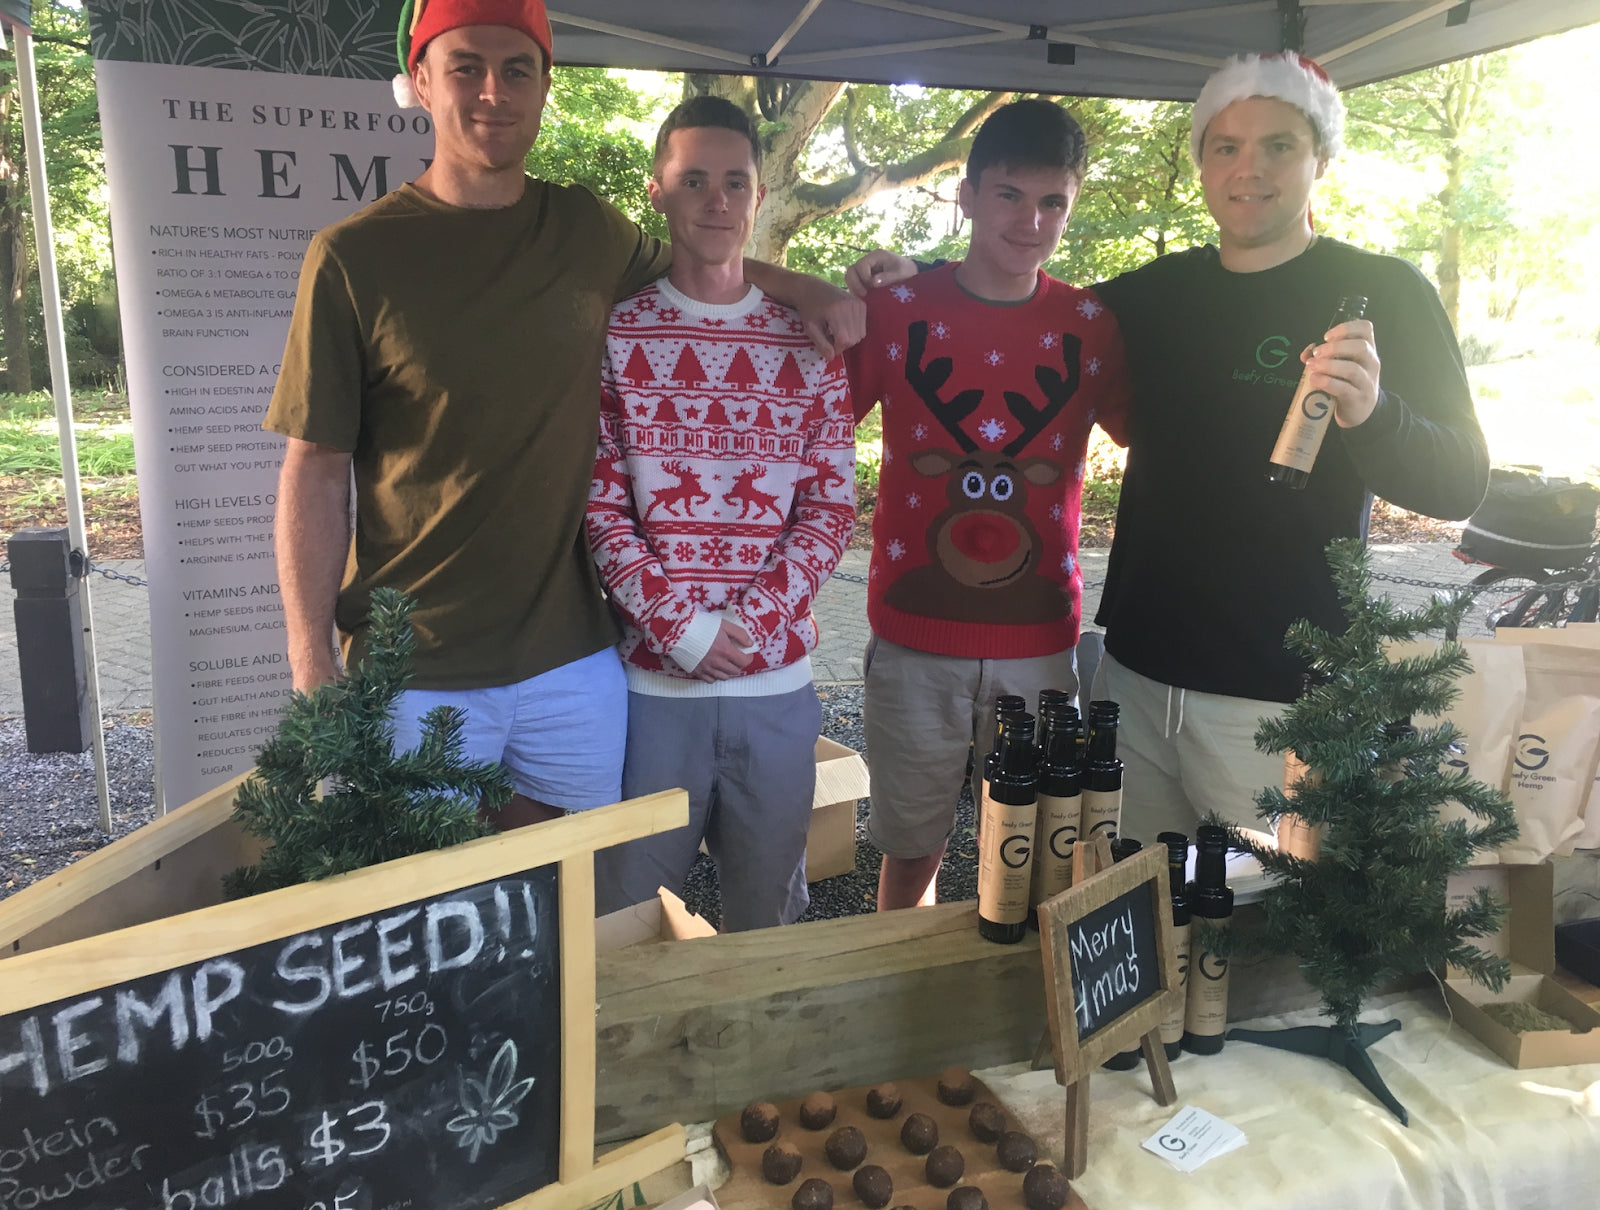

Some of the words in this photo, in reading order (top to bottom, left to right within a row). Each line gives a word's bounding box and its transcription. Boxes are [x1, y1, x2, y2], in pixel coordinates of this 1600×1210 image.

[163, 98, 234, 123] THE
[253, 104, 430, 135] SUPERFOO
[150, 225, 219, 238] NATURE'S
[224, 227, 264, 240] MOST
[268, 229, 318, 241] NUTRIE
[158, 249, 182, 258] RICH
[186, 249, 196, 258] IN
[200, 250, 244, 259] HEALTHY
[246, 251, 270, 260] FATS
[156, 268, 188, 278] RATIO
[190, 269, 206, 278] OF
[208, 270, 222, 279] 3:1
[224, 270, 264, 279] OMEGA
[266, 270, 272, 279] 6
[274, 270, 288, 280] TO
[290, 271, 302, 280] O
[162, 288, 201, 298] OMEGA
[204, 290, 211, 298] 6
[213, 289, 274, 298] METABOLITE
[163, 309, 204, 318] OMEGA
[206, 309, 212, 318] 3
[214, 309, 224, 318] IS
[162, 328, 193, 338] BRAIN
[196, 328, 249, 338] FUNCTION
[162, 365, 255, 377] CONSIDERED
[258, 364, 270, 376] A
[171, 388, 197, 396] HIGH
[200, 388, 210, 396] IN
[213, 386, 254, 396] EDESTIN
[169, 406, 206, 416] AMINO
[208, 406, 238, 414] ACIDS
[240, 404, 262, 414] AND
[174, 426, 203, 434] HEMP
[206, 425, 231, 434] SEED
[176, 445, 206, 454] HEMP
[208, 444, 232, 452] SEED
[236, 442, 276, 452] PROTEIN
[174, 464, 196, 472] OUT
[198, 462, 228, 472] WHAT
[230, 461, 252, 470] YOU
[254, 460, 272, 469] PUT
[175, 498, 210, 510] HIGH
[215, 495, 262, 508] LEVELS
[265, 494, 277, 506] O
[183, 519, 211, 528] HEMP
[214, 517, 244, 527] SEEDS
[246, 514, 275, 524] PROD
[184, 537, 214, 546] HELPS
[216, 536, 242, 545] WITH
[268, 533, 274, 541] P
[186, 554, 234, 565] ARGININE
[236, 553, 244, 562] IS
[246, 551, 275, 560] ANTI-I
[182, 586, 247, 601] VITAMINS
[250, 584, 280, 596] AND
[194, 608, 222, 618] HEMP
[224, 606, 254, 616] SEEDS
[256, 603, 284, 614] INCLU
[189, 656, 249, 672] SOLUBLE
[252, 652, 282, 666] AND
[197, 678, 222, 689] FIBRE
[226, 676, 254, 686] FEEDS
[257, 673, 278, 682] OUR
[198, 696, 219, 706] GUT
[220, 693, 256, 704] HEALTH
[259, 690, 280, 699] AND
[200, 715, 218, 724] THE
[221, 712, 246, 722] FIBRE
[248, 710, 258, 718] IN
[261, 708, 281, 717] HEM
[198, 728, 252, 742] REGULATES
[202, 746, 246, 758] REDUCES
[201, 764, 233, 776] SUGAR
[1530, 773, 1557, 782] Green
[1518, 782, 1544, 790] Hemp
[1070, 907, 1136, 980] Merry
[0, 957, 246, 1097] HEMP
[272, 882, 538, 1015] SEED!!
[350, 1023, 448, 1090] $50
[194, 1068, 291, 1140] $35
[306, 1101, 391, 1166] $3
[0, 1117, 119, 1172] otein
